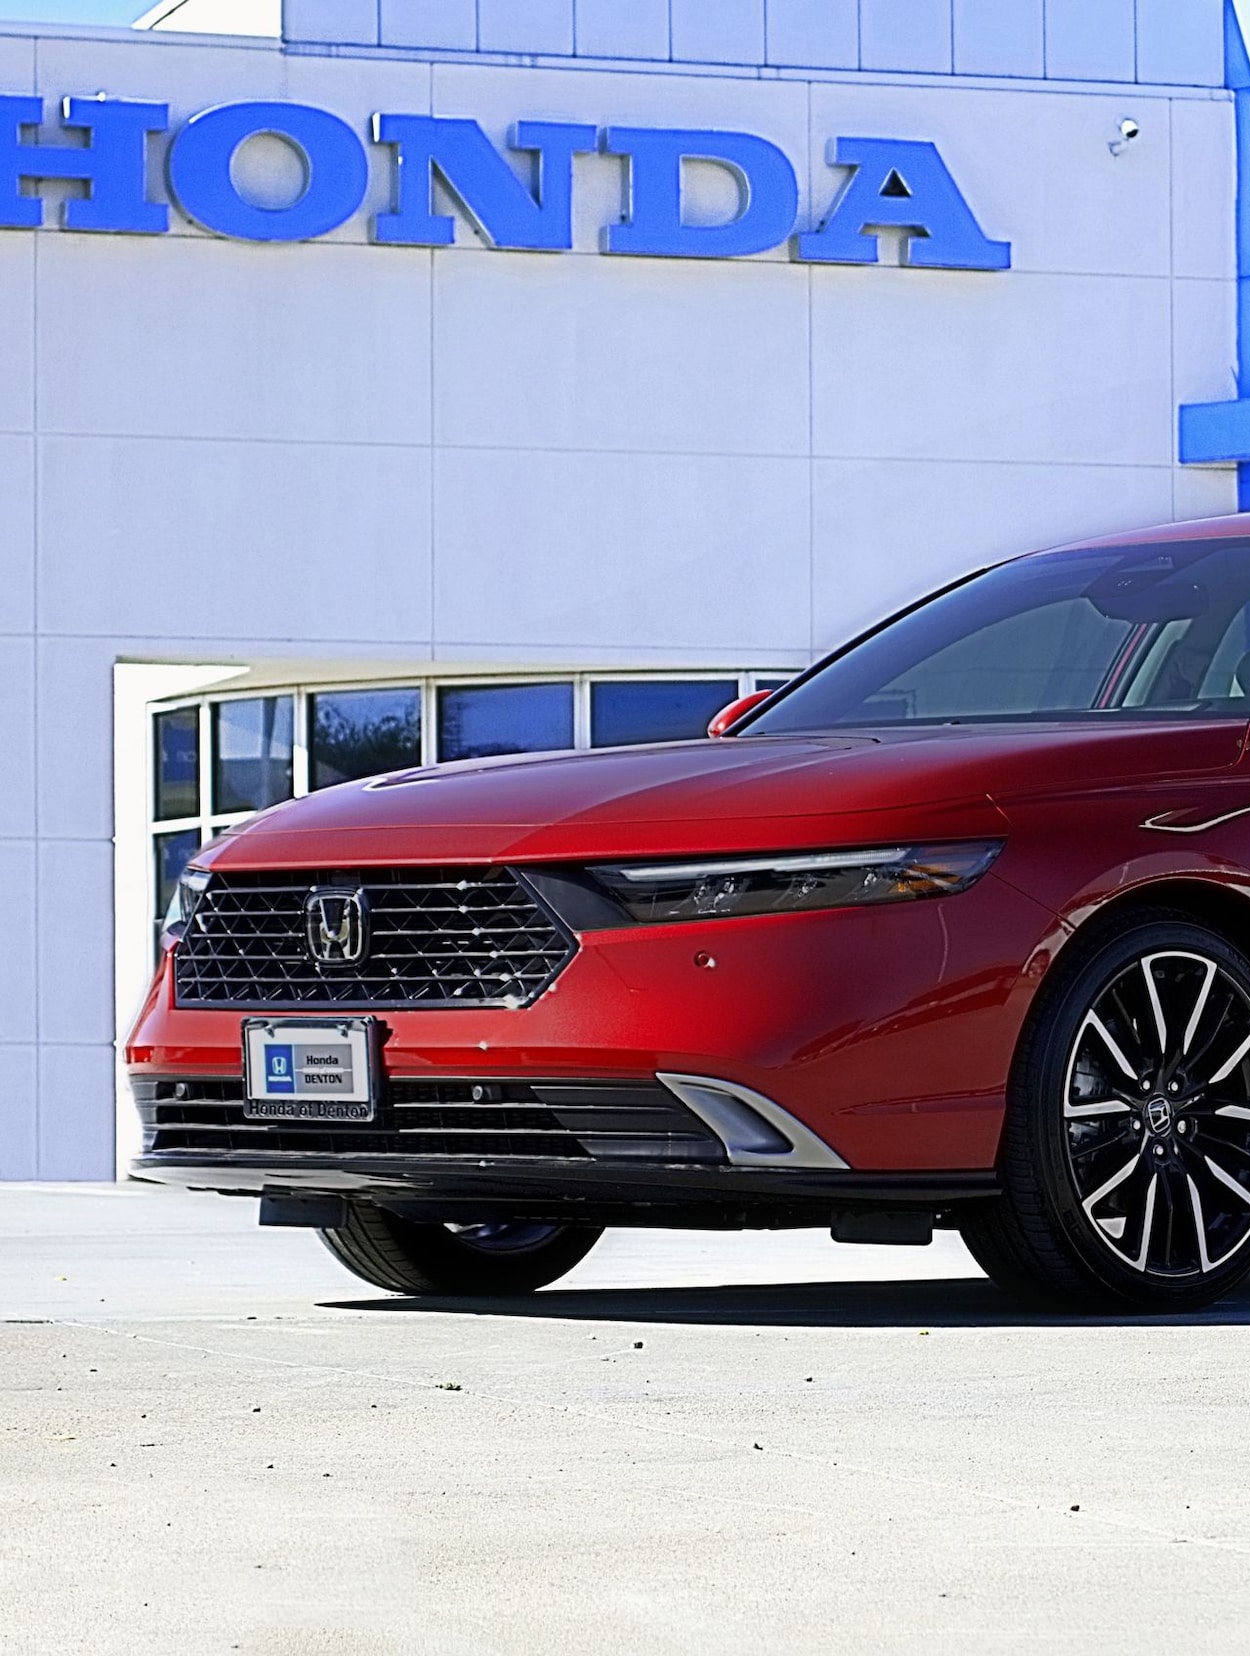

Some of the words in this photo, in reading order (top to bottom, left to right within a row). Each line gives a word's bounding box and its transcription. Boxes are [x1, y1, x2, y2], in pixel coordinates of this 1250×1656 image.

[0, 93, 1011, 271] HONDA
[306, 1055, 339, 1065] Honda
[304, 1074, 342, 1084] DENTON
[249, 1100, 294, 1116] Honda
[299, 1103, 313, 1116] of
[317, 1102, 369, 1118] Denton
